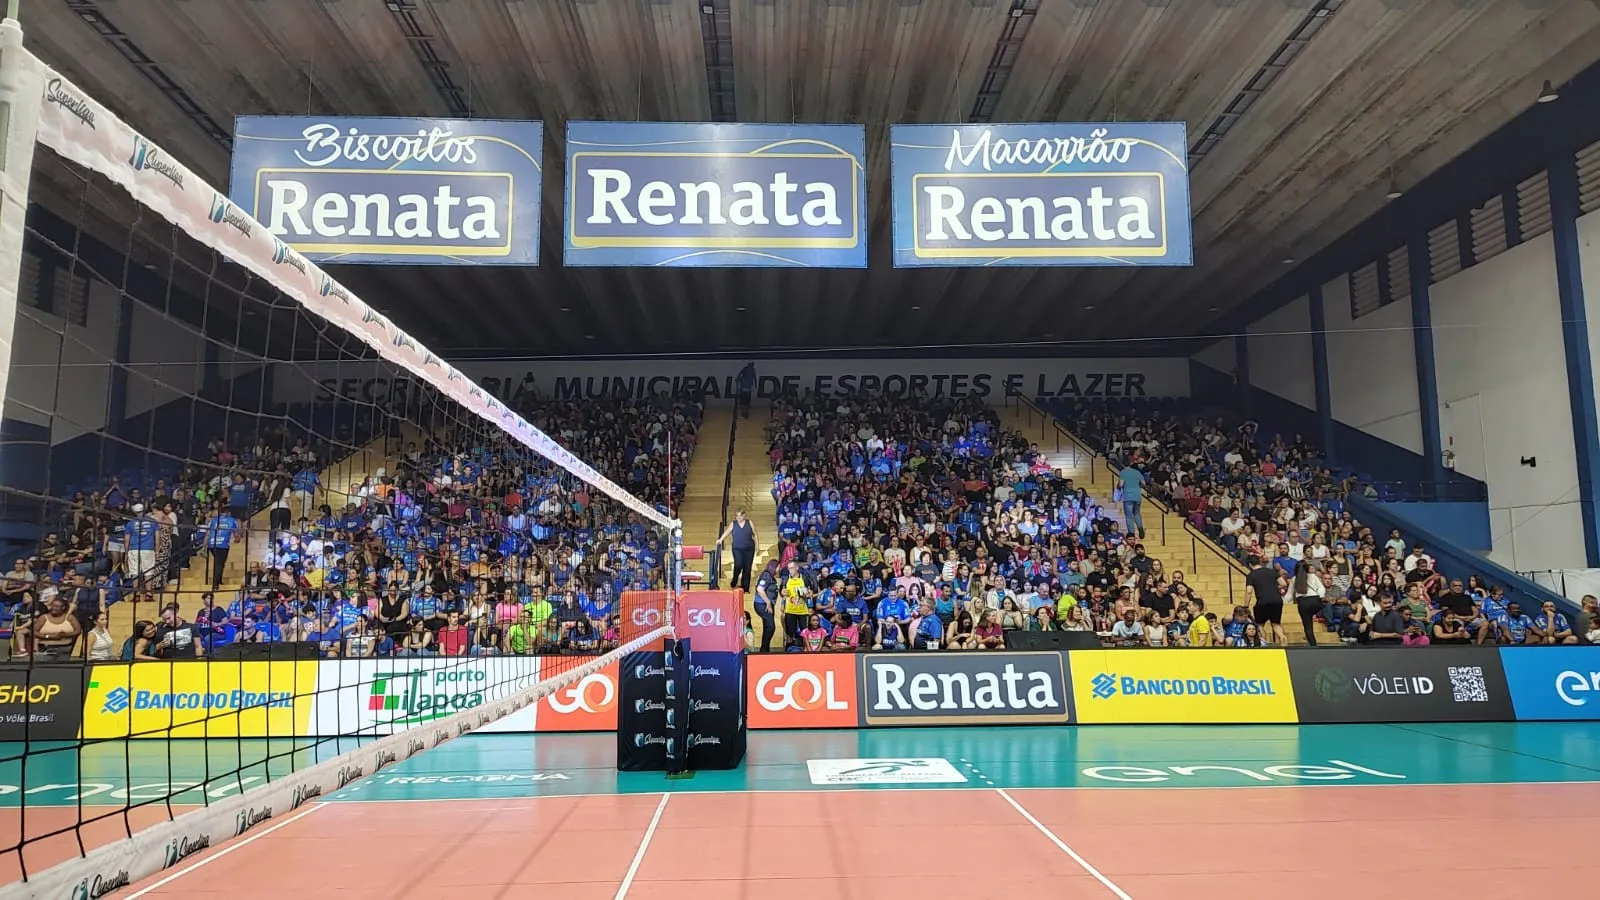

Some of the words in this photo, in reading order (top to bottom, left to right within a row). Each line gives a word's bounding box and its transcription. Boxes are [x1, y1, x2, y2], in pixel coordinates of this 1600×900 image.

[294, 123, 478, 166] Biscoitos
[944, 128, 1140, 171] Macarrão
[266, 180, 500, 240] Renata
[586, 168, 842, 226] Renata
[923, 185, 1156, 241] Renata
[814, 374, 992, 398] ESPORTES
[1006, 374, 1024, 397] E
[1037, 373, 1146, 397] LAZER
[688, 607, 726, 626] GOL
[435, 668, 485, 686] porto
[547, 673, 618, 714] GO
[755, 670, 849, 711] GOL
[872, 663, 1059, 711] Renata
[1120, 676, 1184, 695] BANCO
[1186, 679, 1211, 695] DO
[1212, 676, 1276, 695] BRASIL
[1353, 673, 1410, 695] VÔLEI
[1412, 676, 1434, 694] ID
[134, 690, 200, 709] BANCO
[202, 692, 228, 709] DO
[230, 689, 293, 708] BRASIL
[1082, 759, 1406, 783] enel
